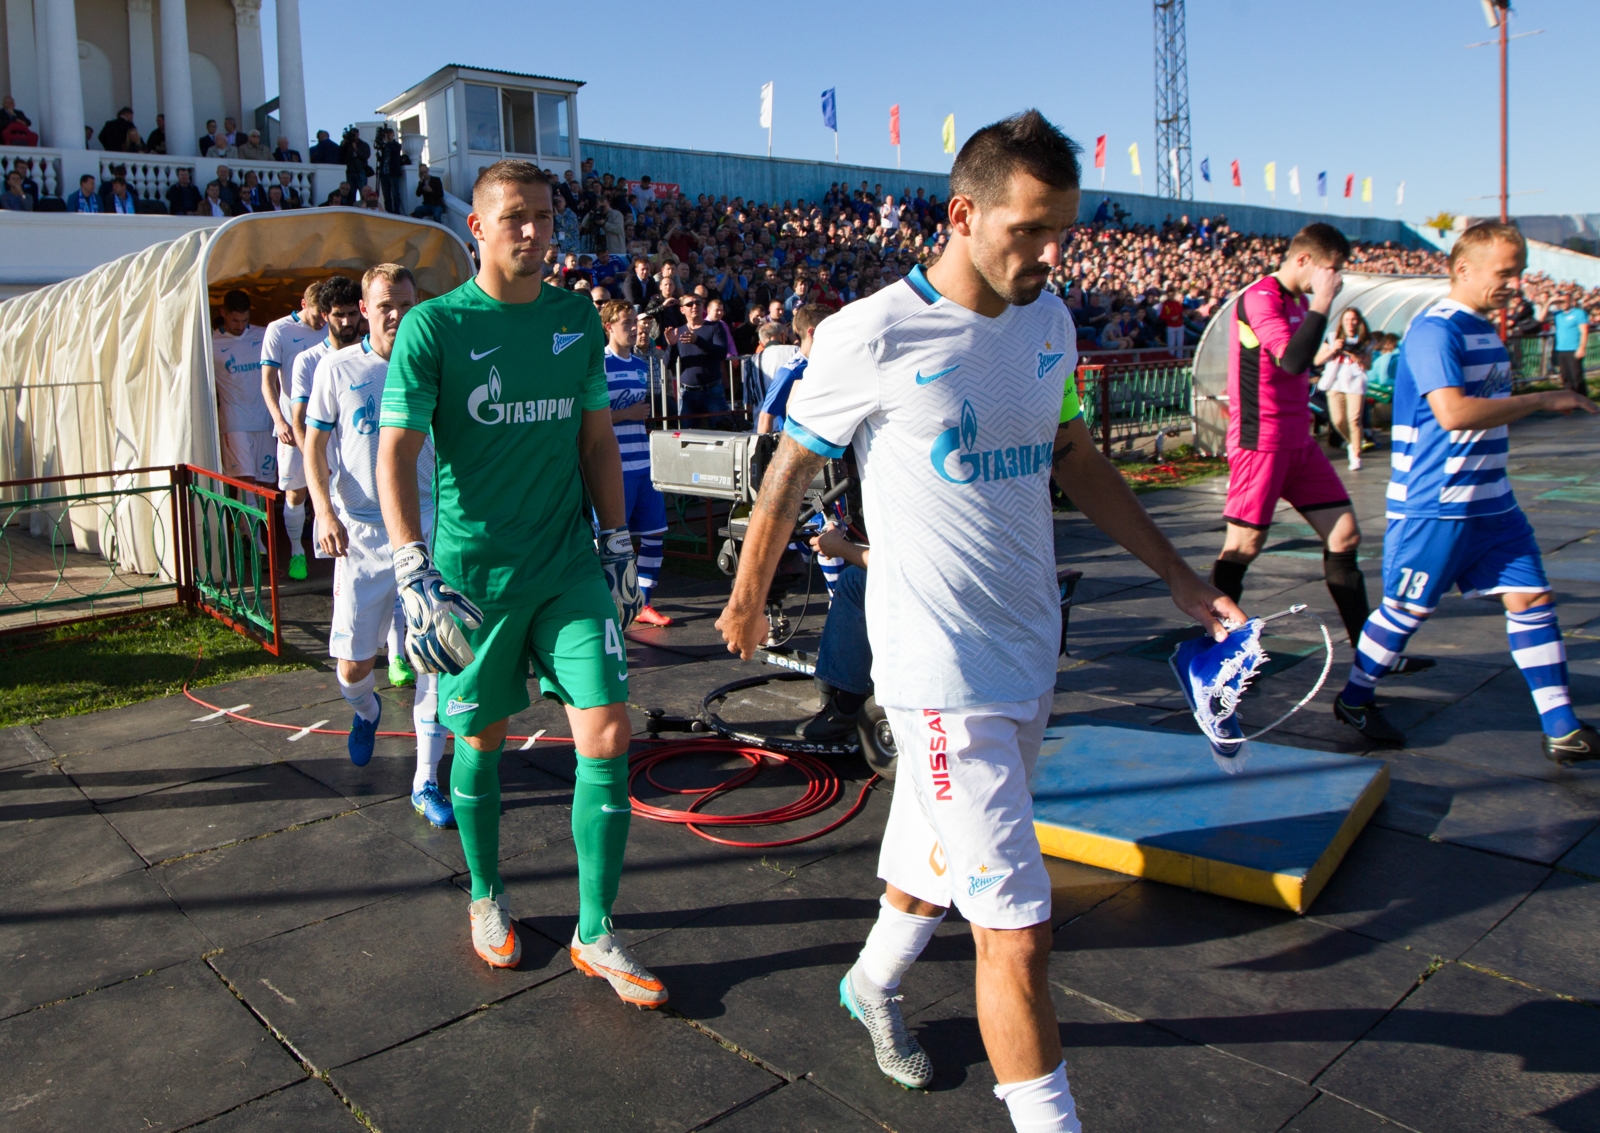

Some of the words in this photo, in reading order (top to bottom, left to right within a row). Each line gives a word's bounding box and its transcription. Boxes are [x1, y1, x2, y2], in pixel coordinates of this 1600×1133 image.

[505, 397, 576, 424] ГАЗПРОМ
[261, 454, 277, 471] 21
[982, 441, 1054, 482] ГАЗПР
[604, 618, 624, 662] 4
[767, 654, 816, 675] EGRIP
